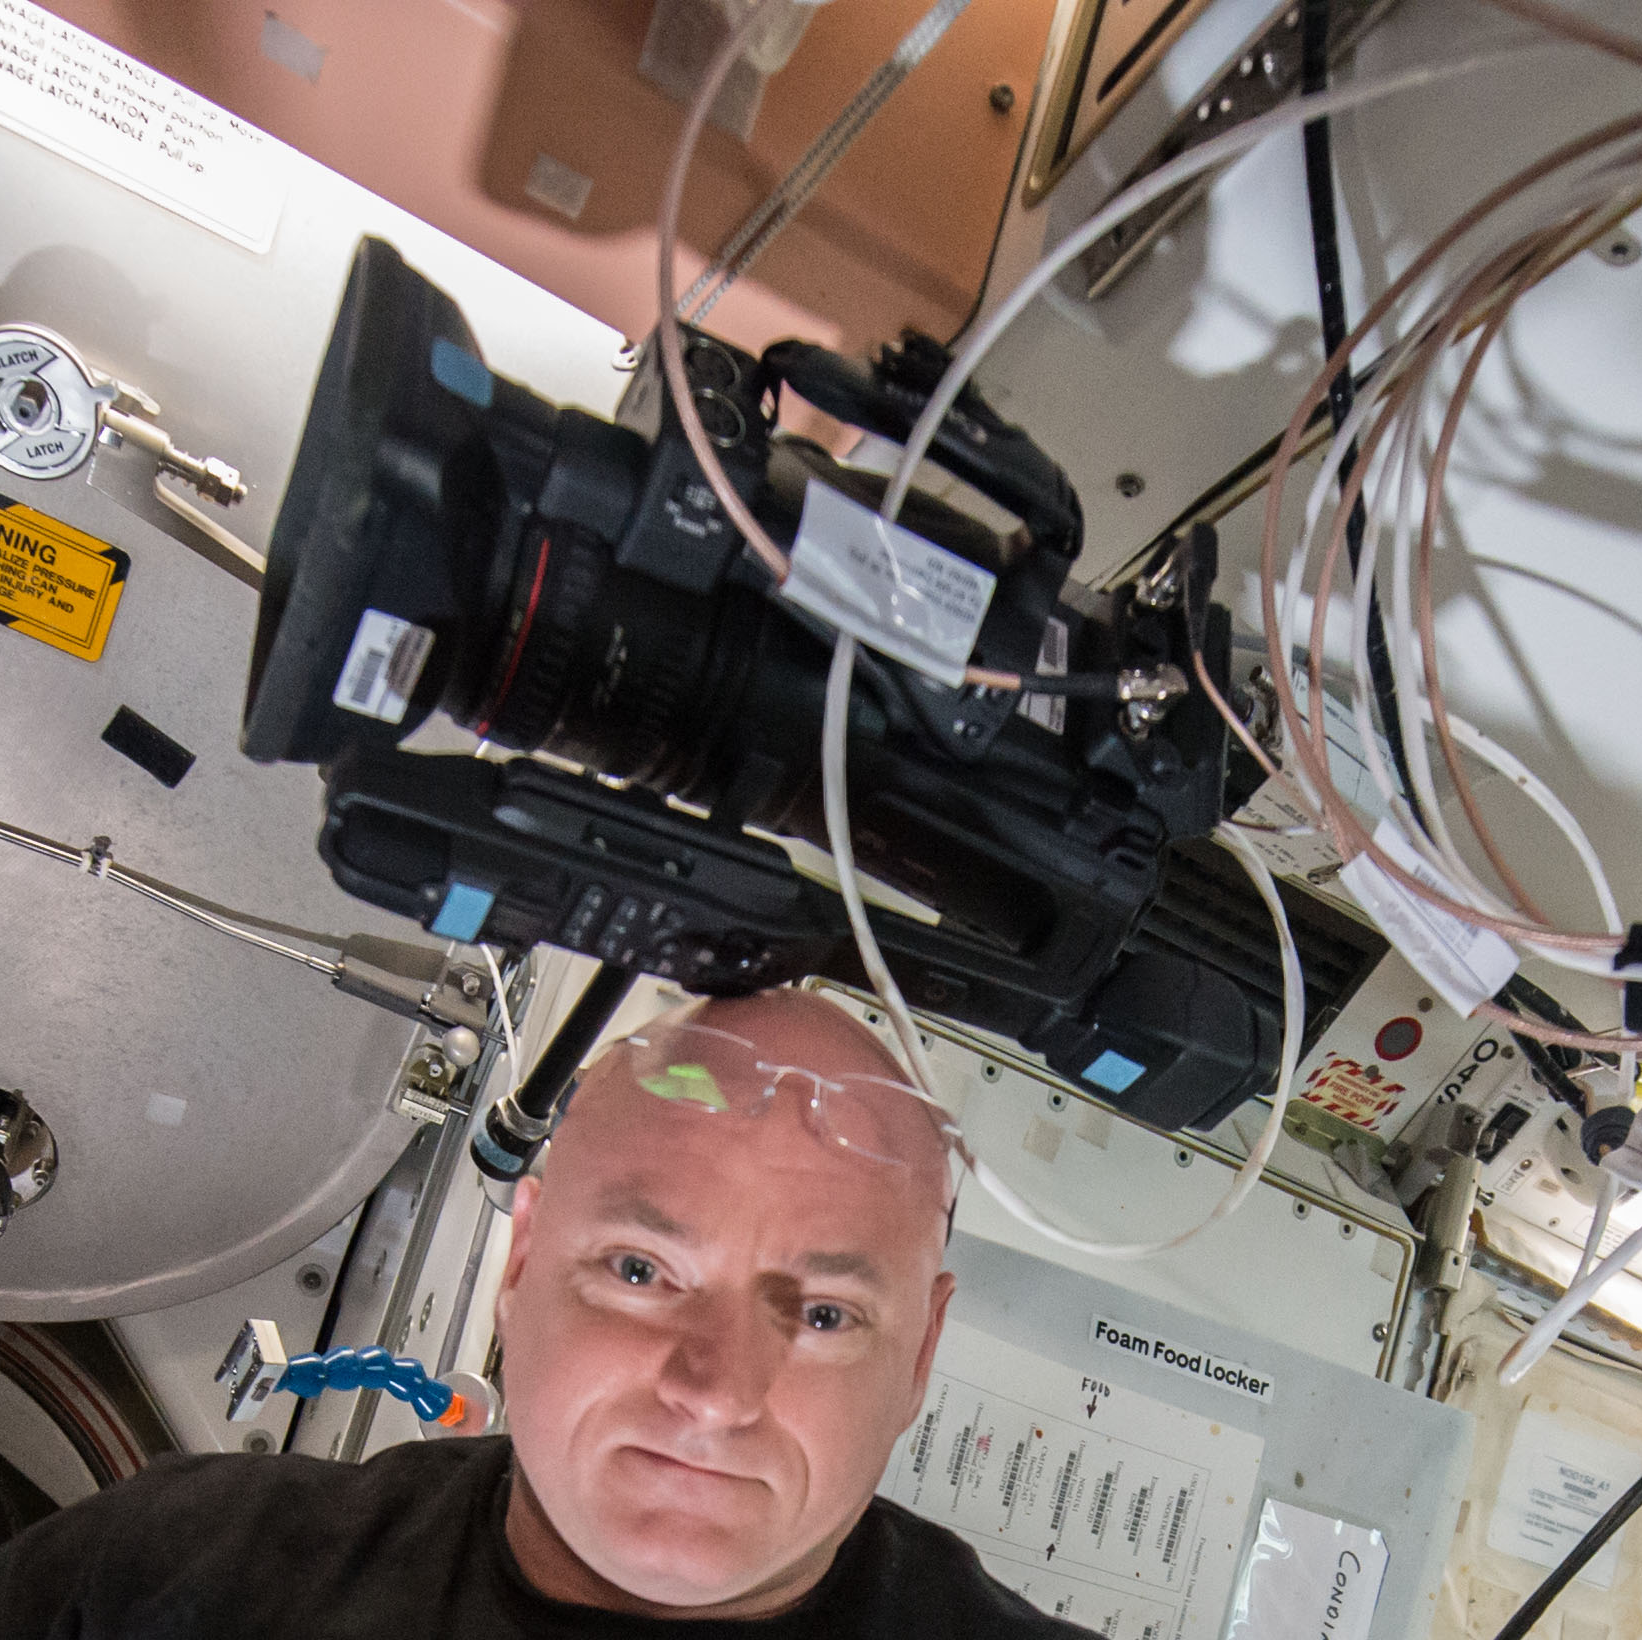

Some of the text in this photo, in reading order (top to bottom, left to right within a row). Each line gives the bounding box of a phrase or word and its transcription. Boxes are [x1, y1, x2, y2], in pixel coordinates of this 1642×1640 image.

[39, 83, 84, 109] LATCH
[88, 105, 146, 142] HANDLE
[43, 65, 87, 91] LATCH
[92, 87, 149, 124] BUTTON
[26, 441, 65, 458] LATCH
[0, 572, 44, 600] INJURY
[48, 595, 75, 614] AND
[30, 574, 59, 594] CAN
[32, 563, 96, 600] PRESSURE
[1095, 1320, 1269, 1396] Foam Food Locker
